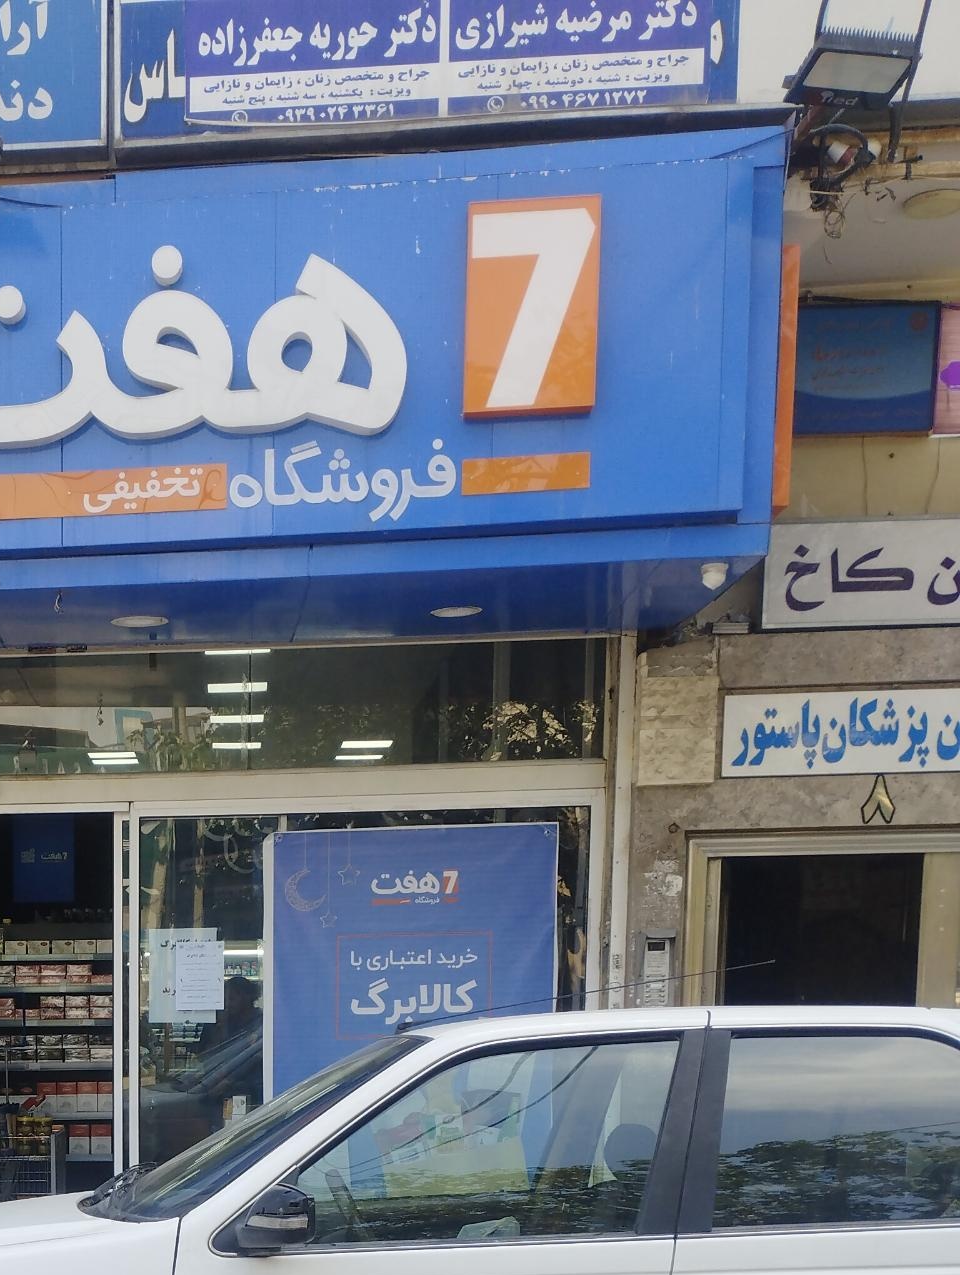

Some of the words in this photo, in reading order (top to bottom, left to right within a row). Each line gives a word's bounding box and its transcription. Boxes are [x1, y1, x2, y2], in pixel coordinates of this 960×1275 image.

[455, 3, 548, 49] شیرازی
[555, 0, 632, 42] مرضیه
[639, 0, 698, 40] دکتر
[198, 17, 302, 66] جعفرزاده
[310, 21, 377, 61] حوریه
[384, 8, 436, 57] دکتر
[510, 61, 549, 77] زایمان
[561, 59, 588, 73] زنان
[592, 57, 643, 71] متخصص
[657, 54, 689, 66] جراح
[254, 77, 293, 90] زایمان
[305, 72, 331, 87] زنان
[334, 72, 384, 86] متخصص
[398, 69, 430, 81] جراح
[544, 76, 584, 88] دوشنبه
[596, 74, 621, 84] شنبه
[633, 72, 670, 83] ویزیت
[378, 87, 411, 98] ویزیت
[471, 207, 598, 409] 7
[83, 466, 201, 513] تخفیفی
[230, 438, 457, 522] فروشگاه
[785, 544, 914, 612] کاخ
[731, 699, 820, 768] پاستور
[822, 697, 928, 768] پزشکان
[371, 870, 440, 894] هفت
[443, 871, 458, 894] 7
[350, 950, 360, 967] با
[367, 949, 431, 970] اعتباری
[437, 949, 478, 969] خرید
[351, 978, 477, 1025] کالابرگ
